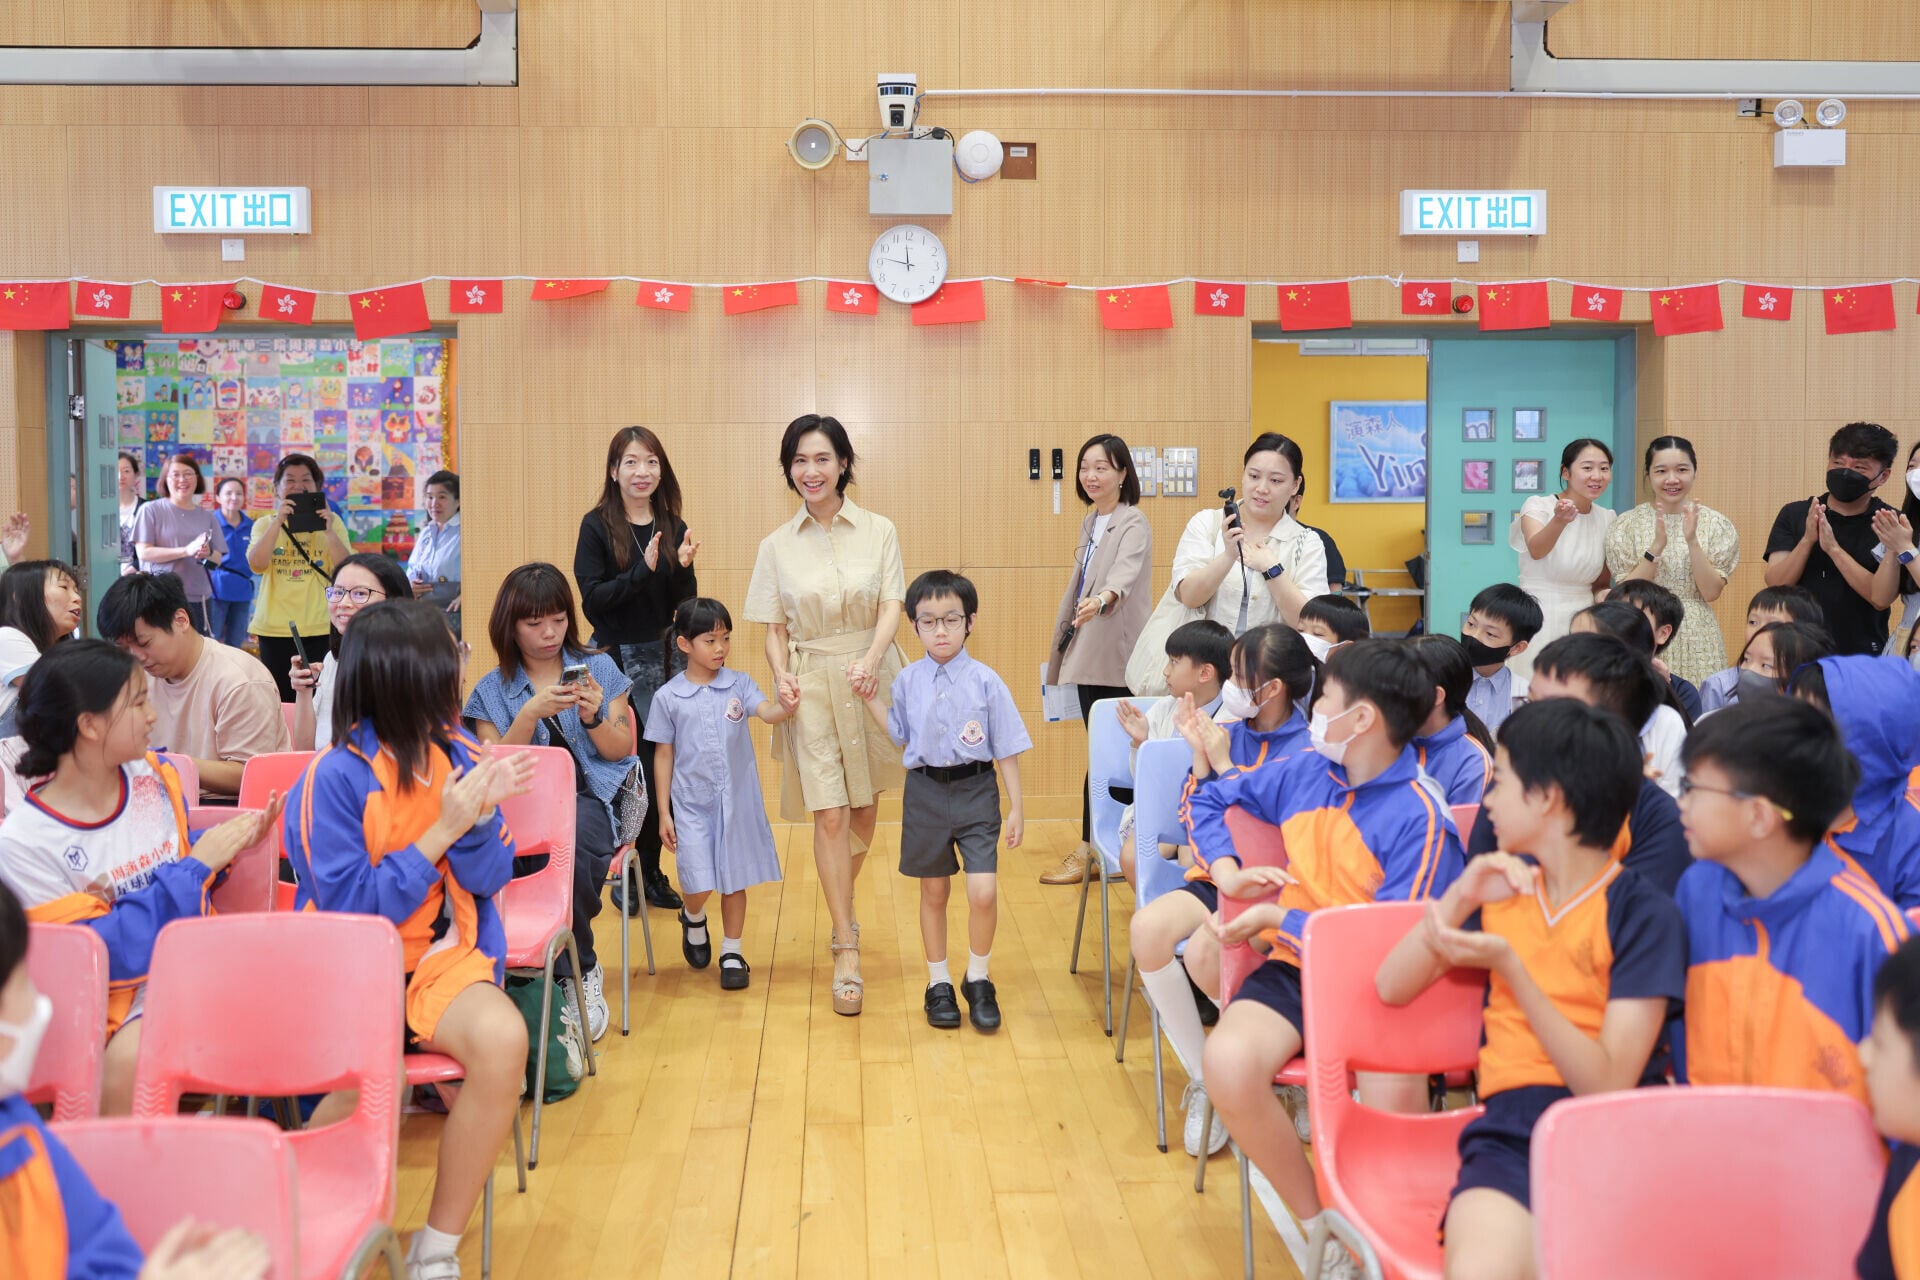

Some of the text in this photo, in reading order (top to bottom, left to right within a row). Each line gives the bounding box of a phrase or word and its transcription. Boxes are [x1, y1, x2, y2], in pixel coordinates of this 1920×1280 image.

[170, 193, 237, 227] EXIT
[243, 193, 291, 227] 出口
[1419, 197, 1481, 228] EXIT
[1487, 197, 1531, 228] 出口
[1345, 410, 1402, 440] 演森人
[111, 840, 174, 881] 周演森小學
